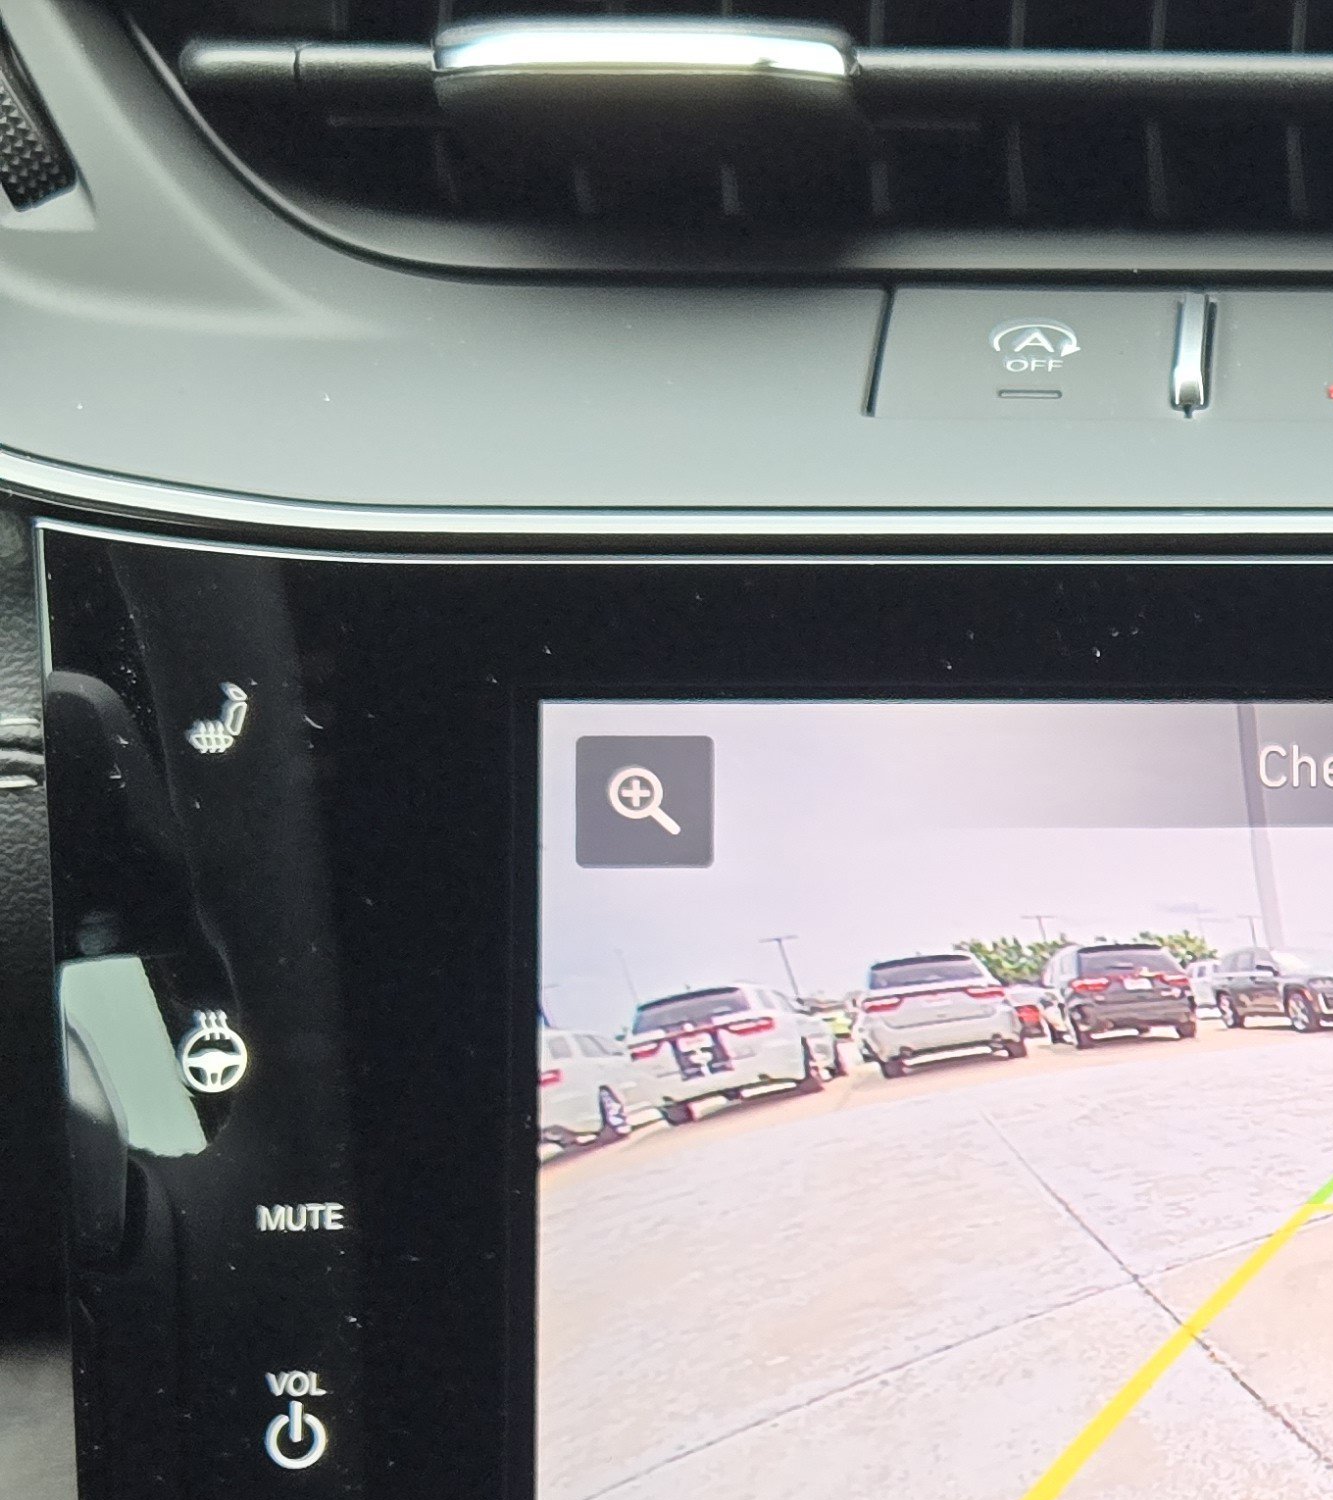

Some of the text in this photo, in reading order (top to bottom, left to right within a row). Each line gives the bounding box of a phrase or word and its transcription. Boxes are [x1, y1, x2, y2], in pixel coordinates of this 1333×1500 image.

[1005, 358, 1064, 373] OFF
[256, 1202, 345, 1233] MUTE
[266, 1371, 328, 1397] VOL
